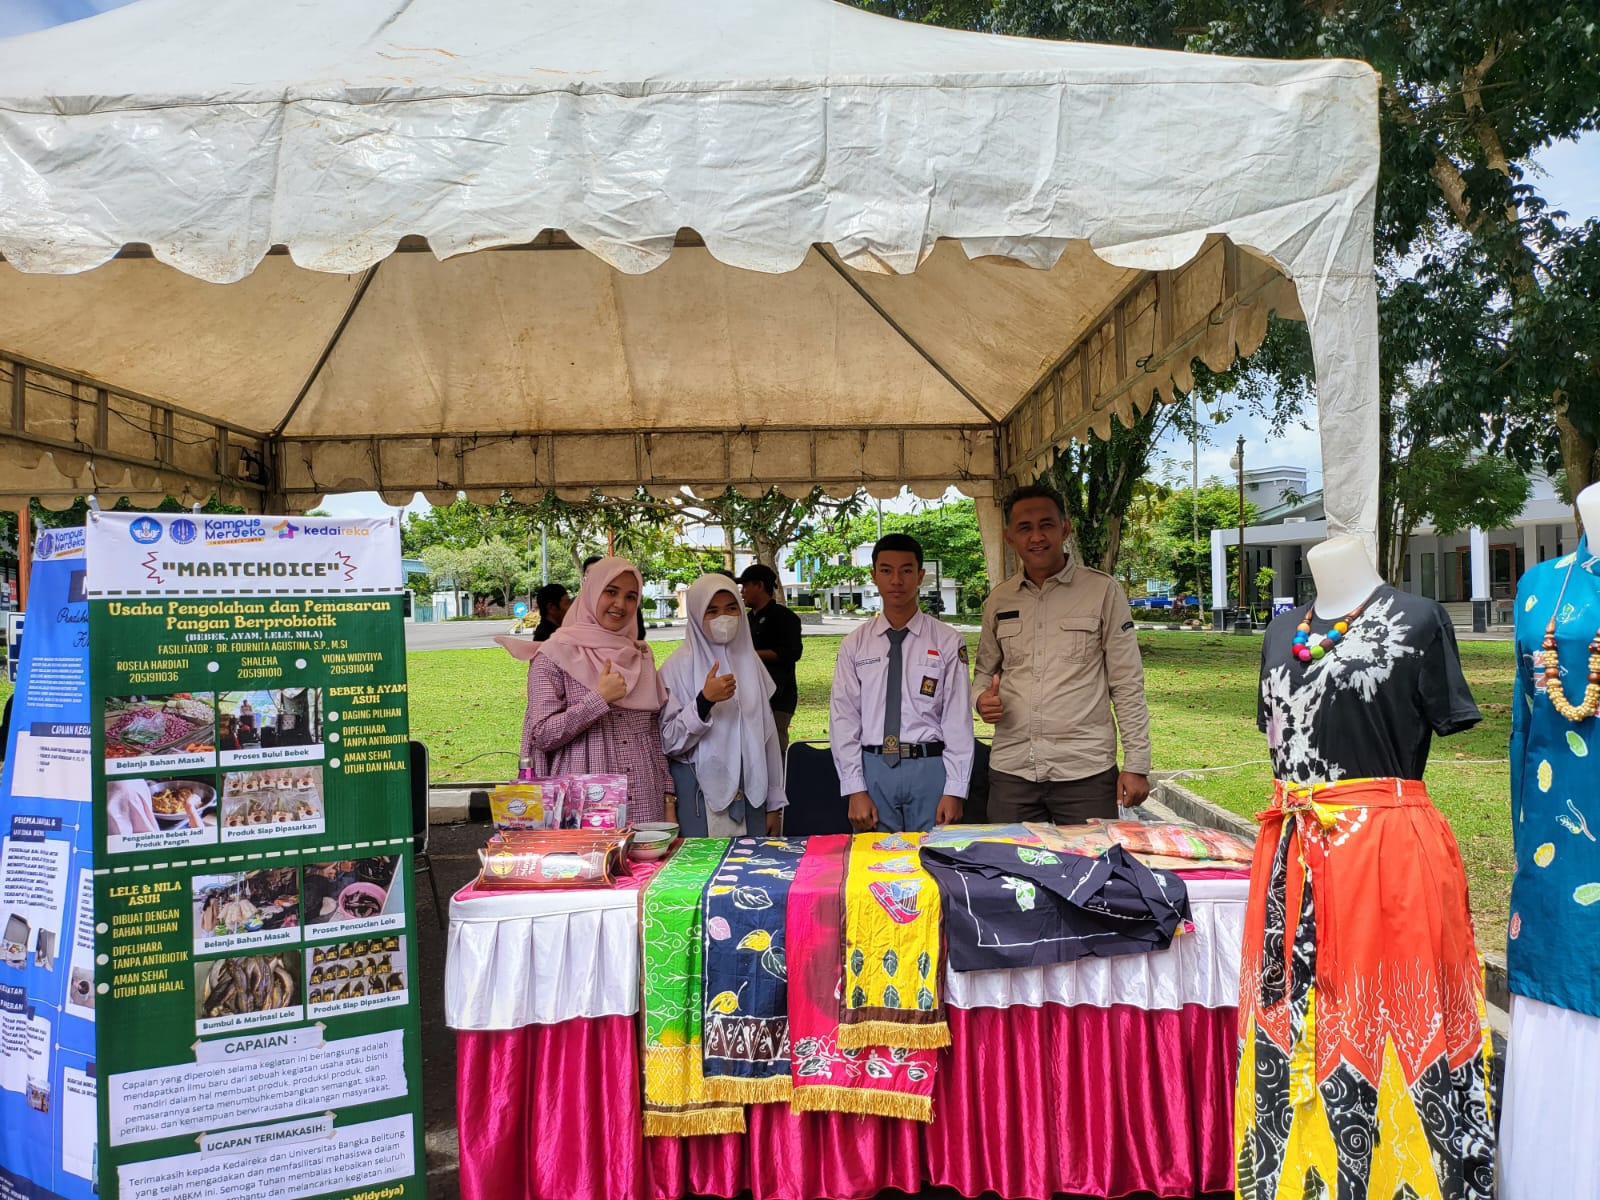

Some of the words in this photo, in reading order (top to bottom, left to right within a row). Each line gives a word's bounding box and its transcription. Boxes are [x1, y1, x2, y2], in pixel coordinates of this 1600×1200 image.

[205, 519, 261, 531] Kampus
[304, 525, 369, 536] kedaireka
[55, 529, 83, 541] Kampus
[205, 528, 266, 540] Merdeka
[55, 539, 85, 552] Merdeka
[162, 562, 340, 577] "MARTCHOICE"
[108, 602, 163, 615] Usaha
[168, 601, 265, 617] Pengolahan
[269, 600, 300, 613] dan
[304, 599, 391, 612] Pemasaran
[166, 617, 230, 632] Pangan
[234, 614, 337, 630] Berprobiotik
[295, 630, 323, 639] NILA)
[158, 644, 208, 655] FASILITATOR
[231, 642, 270, 652] FOURNITA
[331, 640, 348, 649] M.SI
[241, 656, 278, 667] SHALEHA
[322, 653, 346, 663] VIONA
[347, 652, 383, 662] WIDYTIYA
[117, 660, 150, 671] ROSELA
[151, 659, 189, 670] HARDIATI
[330, 664, 374, 675] 2051911044
[129, 672, 179, 683] 2051911036
[237, 667, 282, 679] 2051911010
[329, 686, 364, 696] BEBEK
[366, 685, 374, 694] &
[377, 684, 407, 694] AYAM
[352, 695, 380, 704] ASUH
[342, 710, 371, 720] DAGING
[372, 708, 402, 719] PILIHAN
[342, 725, 386, 736] DIPELIHARA
[343, 737, 368, 747] TANPA
[368, 734, 409, 746] ANTIBIOTIK
[233, 752, 260, 760] Proses
[284, 749, 309, 757] Bebek
[344, 752, 367, 762] AMAN
[368, 750, 392, 761] SEHAT
[116, 761, 148, 769] Belanja
[149, 759, 176, 767] Bahan
[177, 756, 205, 765] Masak
[344, 763, 365, 774] UTUH
[366, 762, 382, 772] DAN
[383, 761, 406, 771] HALAL
[122, 833, 165, 843] Pengolahan
[165, 830, 188, 838] Bebek
[227, 829, 256, 837] Produk
[274, 823, 317, 834] Dipasarkan
[135, 840, 162, 849] Produk
[163, 838, 190, 847] Pangan
[109, 885, 140, 898] LELE
[142, 884, 151, 894] &
[153, 881, 182, 893] NILA
[128, 893, 161, 906] ASUH
[112, 912, 143, 926] DIBUAT
[145, 909, 180, 922] DENGAN
[113, 926, 142, 938] BAHAN
[145, 922, 178, 935] PILIHAN
[312, 926, 339, 935] Proses
[340, 919, 379, 931] Pencucian
[381, 917, 396, 926] Lele
[204, 939, 235, 949] Belanja
[236, 935, 263, 945] Bahan
[264, 932, 291, 942] Masak
[113, 941, 163, 957] DIPELIHARA
[113, 957, 141, 970] TANPA
[142, 951, 189, 965] ANTIBIOTIK
[113, 972, 140, 985] AMAN
[141, 969, 169, 981] SEHAT
[113, 985, 137, 999] UTUH
[139, 983, 157, 995] DAN
[159, 980, 185, 993] HALAL
[313, 1004, 341, 1014] Produk
[360, 995, 401, 1007] Dipasarkan
[244, 1014, 278, 1024] Marinasi
[279, 1010, 295, 1018] Lele
[224, 1035, 288, 1054] CAPAIAN
[122, 1079, 159, 1090] Capaian
[160, 1076, 182, 1086] yang
[184, 1069, 226, 1081] diperoleh
[227, 1064, 258, 1074] selama
[259, 1057, 296, 1069] kegiatan
[309, 1047, 360, 1060] berlangsung
[361, 1042, 389, 1052] adalah
[123, 1086, 185, 1101] mendapatkan
[187, 1082, 206, 1092] ilmu
[208, 1078, 229, 1088] baru
[230, 1075, 248, 1084] dari
[249, 1070, 280, 1081] sebuah
[281, 1064, 318, 1076] kegiatan
[319, 1061, 344, 1070] usaha
[345, 1057, 365, 1066] atau
[366, 1052, 389, 1062] bisnis
[133, 1101, 168, 1111] mandiri
[169, 1095, 197, 1105] dalam
[199, 1091, 212, 1100] hal
[214, 1086, 256, 1097] membuat
[292, 1074, 330, 1086] produksi
[364, 1064, 380, 1073] dan
[125, 1106, 191, 1125] pemasarannya
[192, 1103, 215, 1112] serta
[216, 1085, 320, 1109] menumbuhkembangkan
[160, 1119, 178, 1129] dan
[179, 1112, 235, 1127] kemampuan
[236, 1101, 294, 1116] berwirausaha
[295, 1094, 341, 1107] dikalangan
[207, 1136, 252, 1151] UCAPAN
[254, 1124, 326, 1144] TERIMAKASIH:
[129, 1171, 185, 1187] Terimakasih
[186, 1164, 221, 1177] kepada
[222, 1156, 267, 1170] Kedaireka
[269, 1153, 287, 1162] dan
[289, 1144, 337, 1158] Universitas
[338, 1137, 369, 1149] Bangka
[371, 1130, 406, 1143] Belitung
[135, 1186, 159, 1199] yang
[160, 1183, 184, 1193] telah
[186, 1172, 245, 1189] mengadakan
[247, 1167, 265, 1177] dan
[266, 1158, 324, 1174] memfasilitasi
[325, 1150, 373, 1163] mahasiswa
[374, 1143, 400, 1154] dalam
[173, 1190, 203, 1200] MBKM
[220, 1182, 256, 1195] Semoga
[258, 1176, 286, 1187] Tuhan
[288, 1168, 332, 1181] membalas
[334, 1160, 373, 1173] kebaikan
[374, 1153, 406, 1165] seluruh
[268, 1186, 286, 1197] dan
[287, 1177, 344, 1193] melancarkan
[345, 1168, 383, 1182] kegiatan
